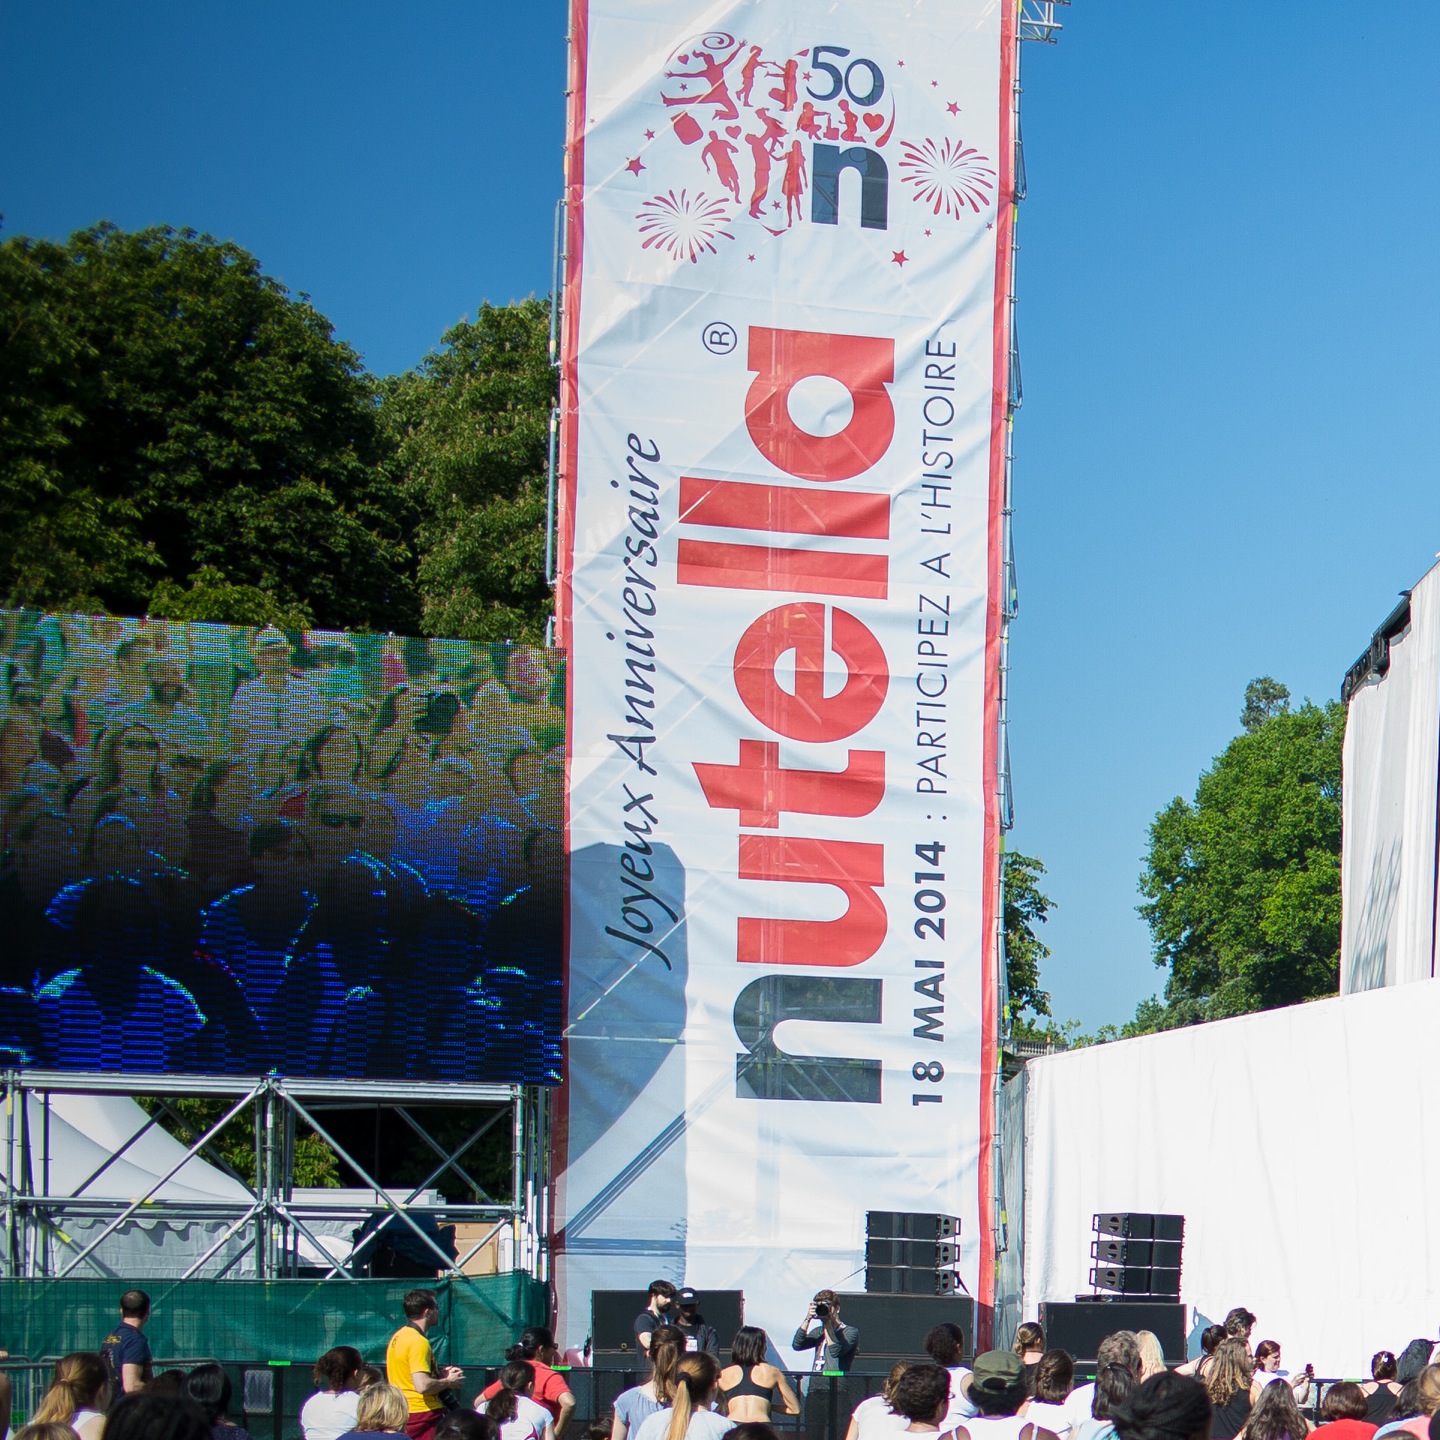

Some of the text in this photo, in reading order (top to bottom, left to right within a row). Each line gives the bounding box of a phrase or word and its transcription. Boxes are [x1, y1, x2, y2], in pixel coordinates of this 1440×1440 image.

[806, 46, 885, 107] 50
[811, 142, 889, 230] n
[922, 339, 957, 536] L'HISTOIRE
[920, 552, 952, 579] A
[605, 433, 679, 971] Joyeux Anniversaire
[677, 325, 896, 1104] nutella
[916, 595, 951, 794] PARTICIPEZ
[914, 840, 946, 941] 2014
[913, 960, 946, 1042] MAI
[912, 1060, 945, 1106] 18
